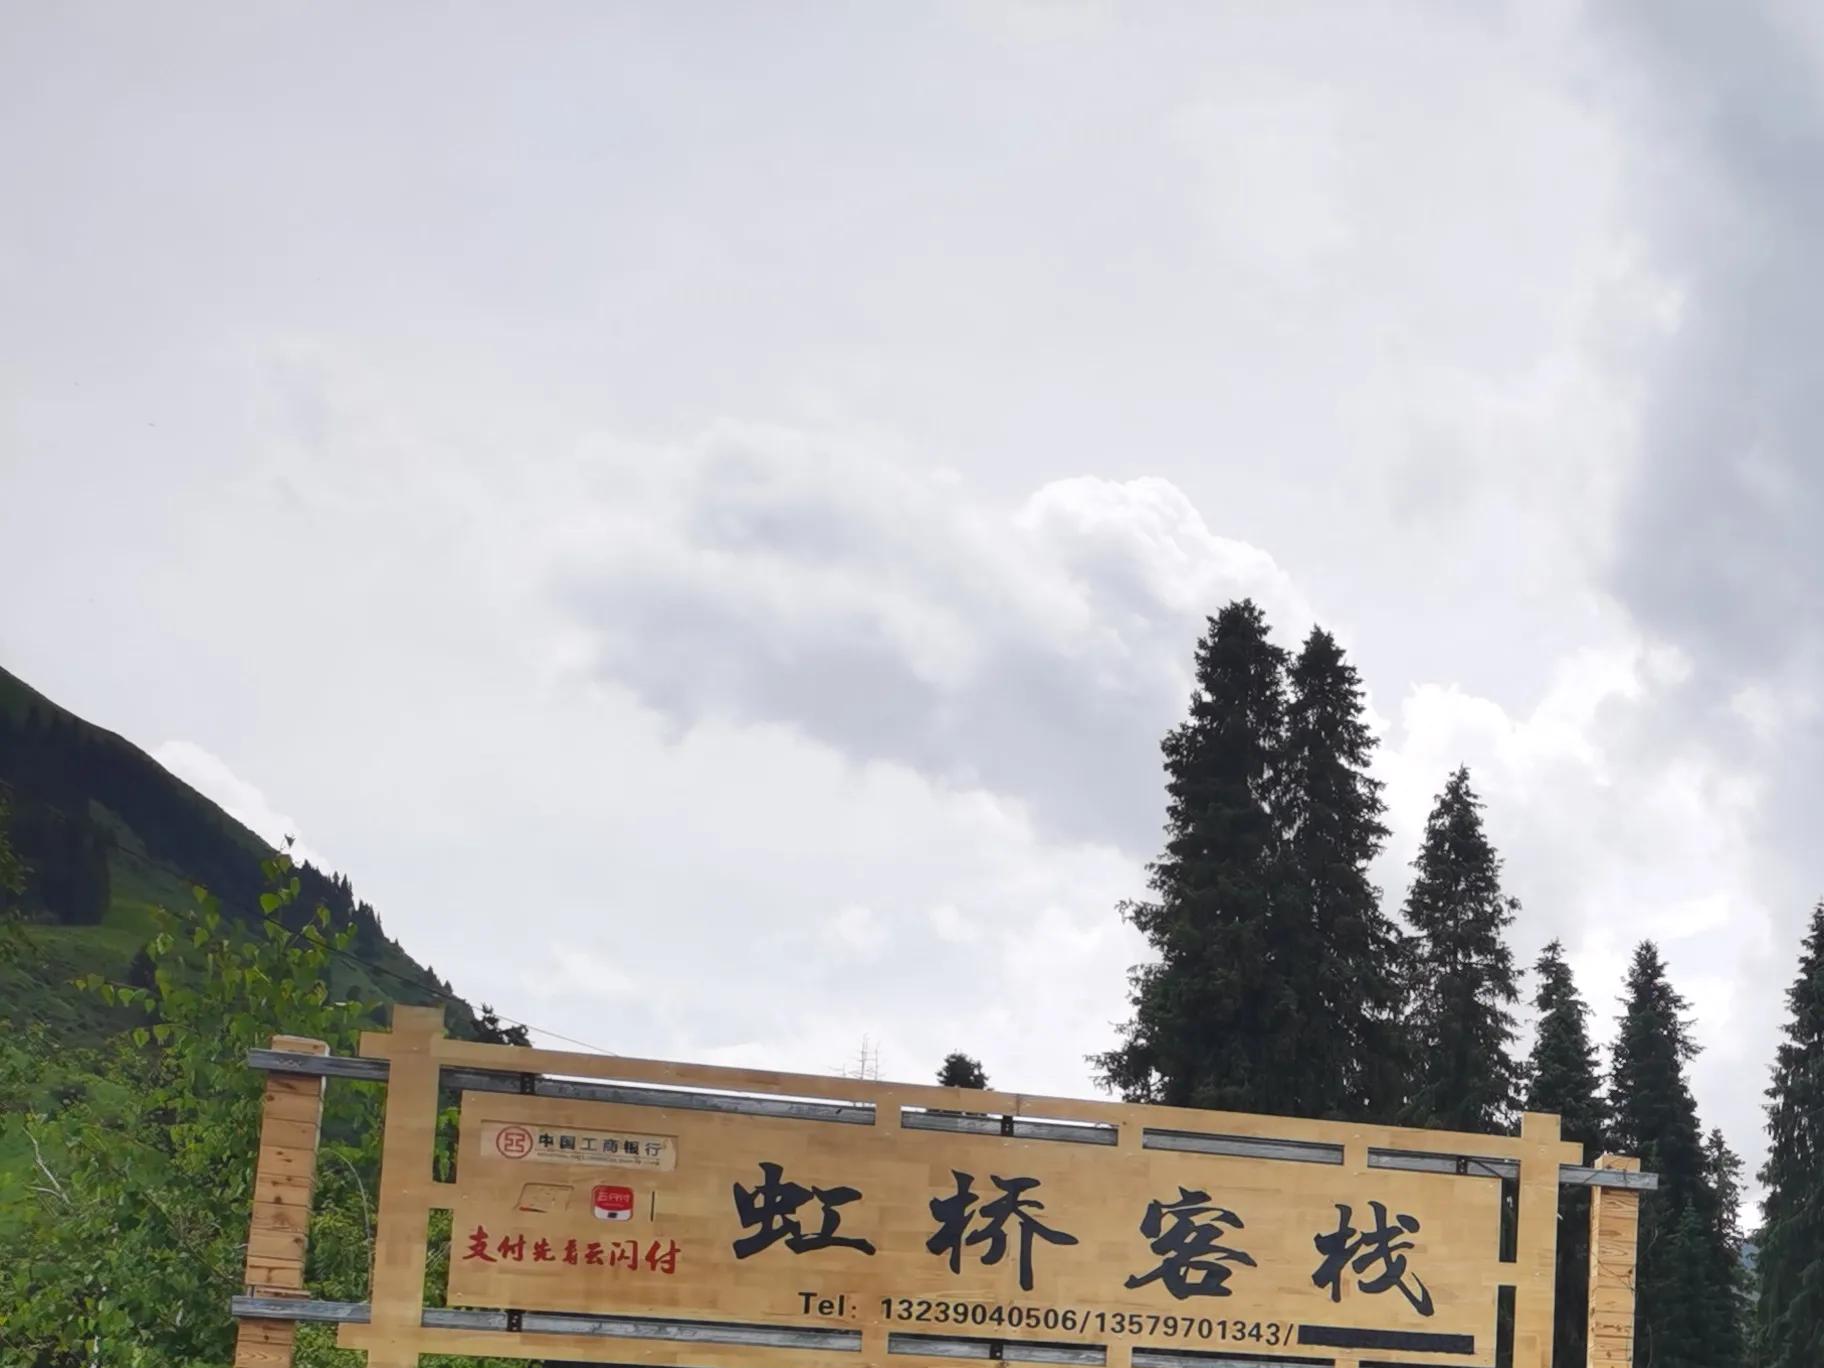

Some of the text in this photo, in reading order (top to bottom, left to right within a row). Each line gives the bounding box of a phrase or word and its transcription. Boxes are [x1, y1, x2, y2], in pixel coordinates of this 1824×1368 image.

[538, 1133, 662, 1157] 中国工商银行
[732, 1161, 1436, 1317] 虹桥客栈
